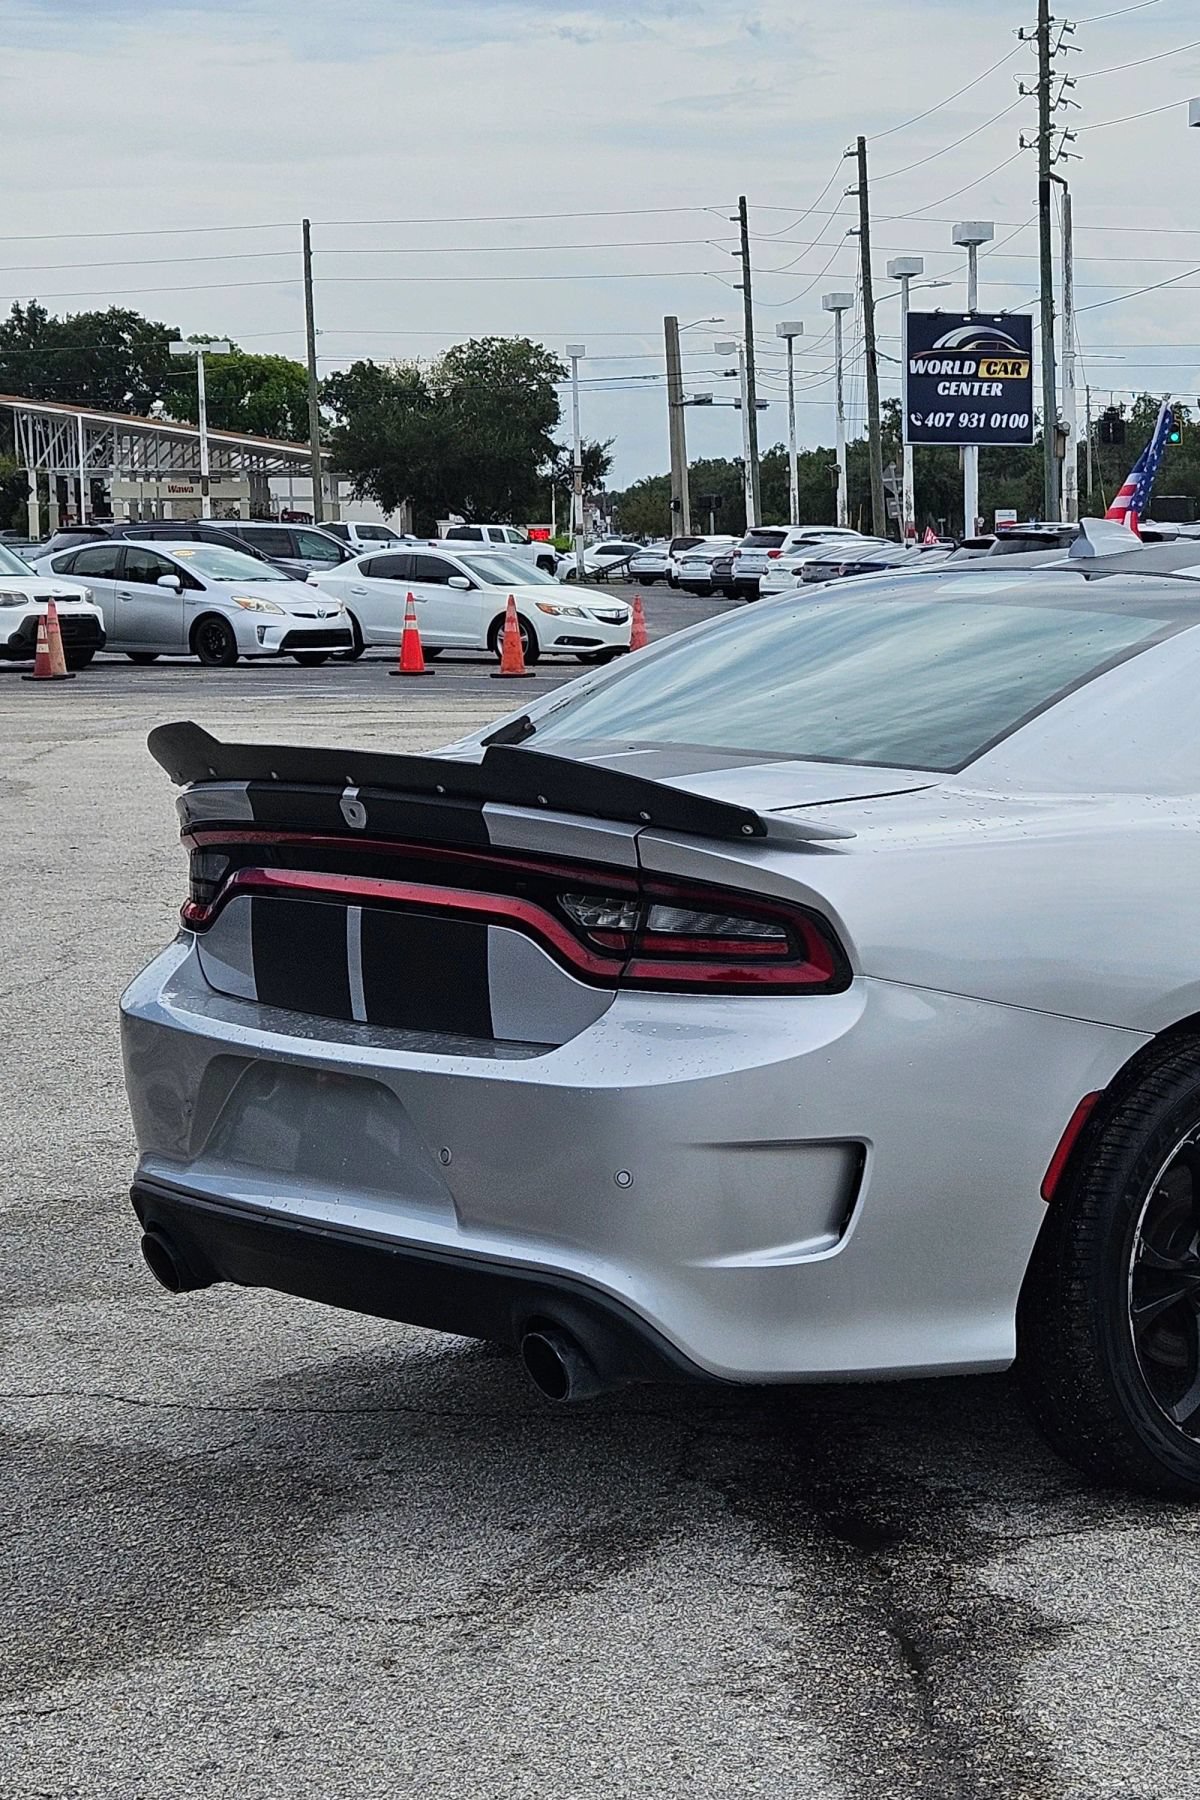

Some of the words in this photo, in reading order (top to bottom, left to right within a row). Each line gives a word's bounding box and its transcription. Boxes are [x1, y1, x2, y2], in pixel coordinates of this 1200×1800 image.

[909, 359, 977, 375] WORLD
[985, 361, 1022, 376] CAR
[936, 381, 1004, 397] CENTER
[924, 412, 955, 428] 407
[958, 412, 986, 428] 931
[990, 413, 1029, 429] 0100
[167, 484, 194, 494] Wawa
